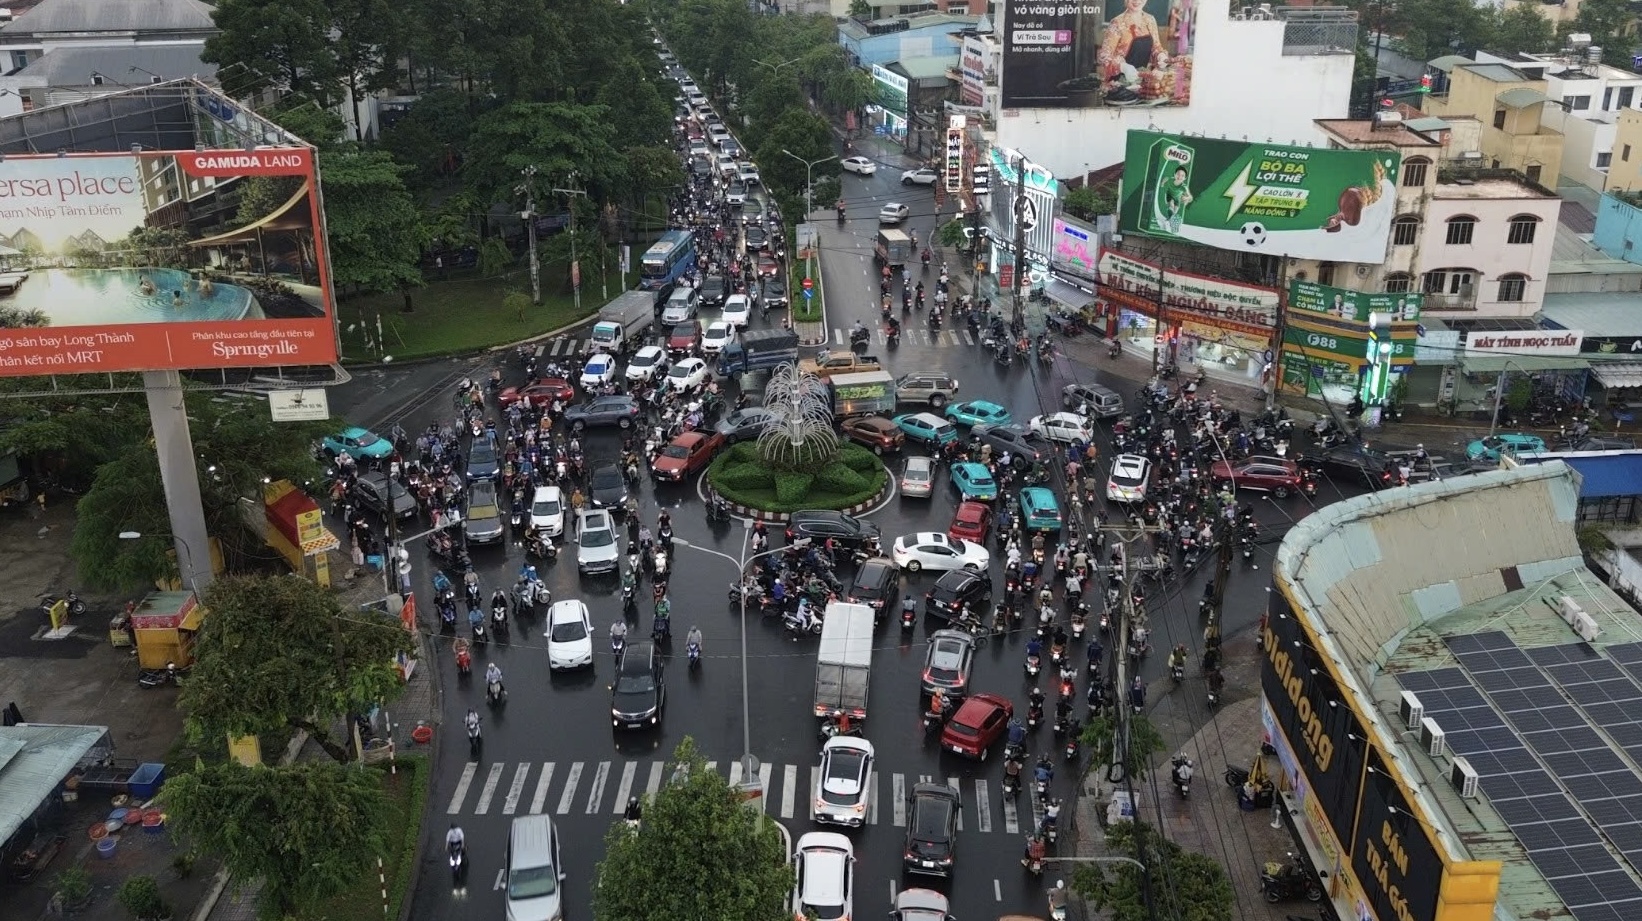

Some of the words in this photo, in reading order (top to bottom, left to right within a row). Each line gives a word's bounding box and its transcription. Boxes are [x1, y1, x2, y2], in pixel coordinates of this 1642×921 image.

[1014, 5, 1027, 15] vỏ
[1029, 5, 1055, 17] vàng
[1057, 4, 1080, 16] giòn
[1083, 4, 1100, 14] tan
[1168, 149, 1188, 161] MILO
[1264, 149, 1288, 158] TRAO
[1289, 152, 1309, 160] CON
[195, 156, 261, 169] GAMUDA
[264, 155, 302, 168] LAND
[1260, 160, 1283, 172] BỘ
[1284, 162, 1305, 174] BA
[1256, 171, 1277, 182] LỢI
[1279, 173, 1306, 184] THẾ
[57, 170, 135, 202] place
[1263, 188, 1279, 196] CAO
[1270, 198, 1293, 207] TRUNG
[16, 336, 38, 348] sân
[39, 336, 61, 349] bay
[64, 335, 95, 348] Long
[95, 332, 135, 345] Thành
[233, 331, 248, 339] cao
[1307, 333, 1337, 350] F88
[1496, 335, 1522, 348] TÍNH
[1522, 338, 1549, 349] NGỌC
[1550, 332, 1578, 347] TUẤN
[212, 340, 298, 360] Springville
[24, 354, 43, 366] kết
[67, 350, 103, 364] MRT
[1382, 820, 1409, 877] BÁN
[1366, 837, 1389, 894] TRẢ
